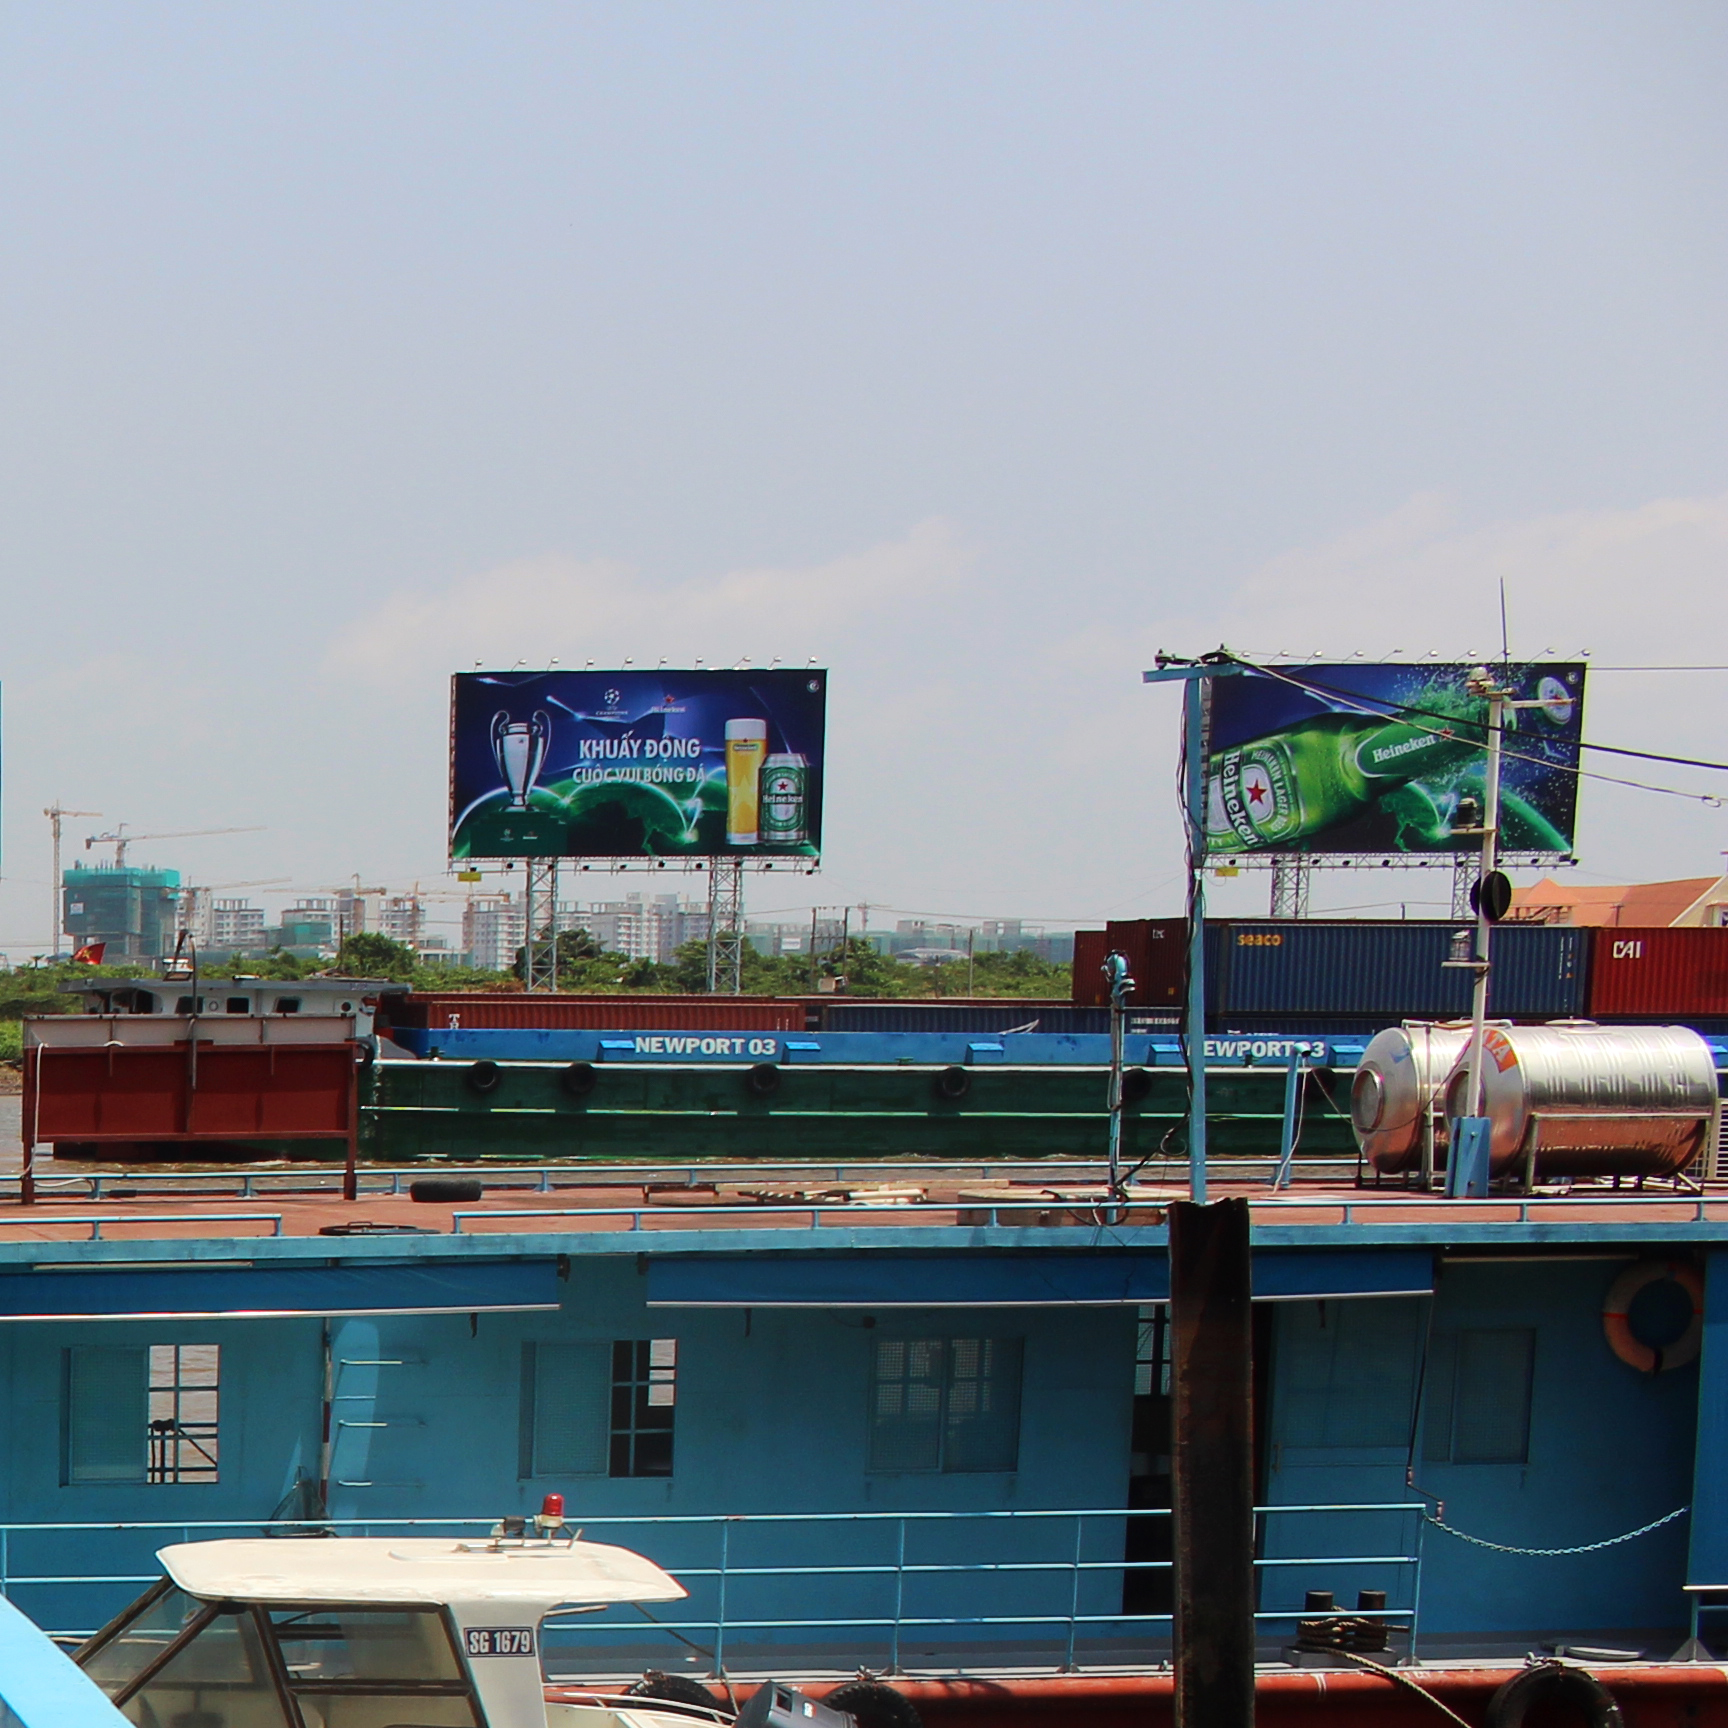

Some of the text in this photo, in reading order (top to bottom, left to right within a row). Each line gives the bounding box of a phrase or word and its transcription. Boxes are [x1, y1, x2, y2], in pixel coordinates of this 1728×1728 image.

[579, 729, 702, 763] KHUẤY ĐỘNG
[1372, 734, 1436, 764] Heineken
[572, 762, 706, 787] CUỘC VUI BÓNG ĐÁ
[1224, 750, 1259, 846] Heineken
[1237, 934, 1282, 947] seaco
[1612, 941, 1642, 959] CAI
[634, 1037, 776, 1056] NEWPORT 03
[1187, 1041, 1295, 1058] EWPORT
[469, 1631, 531, 1653] SG 1679
